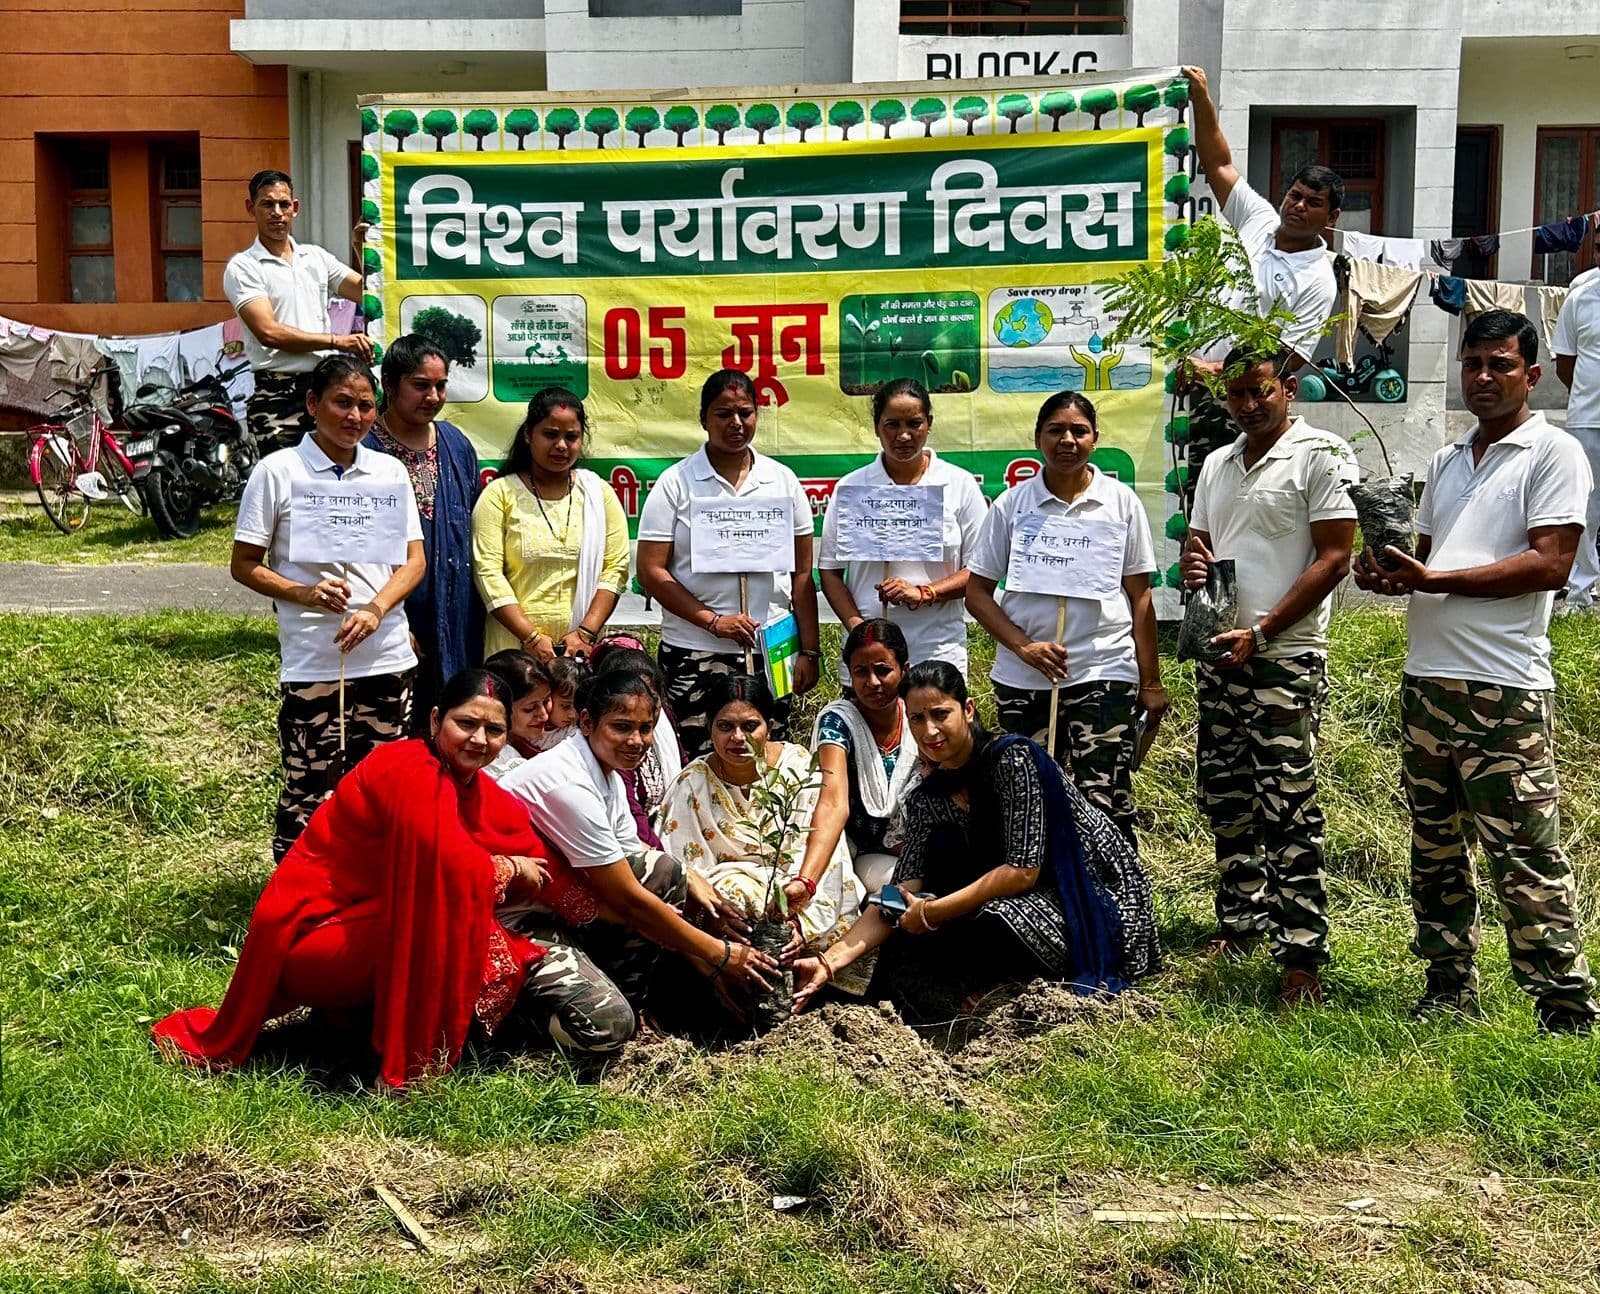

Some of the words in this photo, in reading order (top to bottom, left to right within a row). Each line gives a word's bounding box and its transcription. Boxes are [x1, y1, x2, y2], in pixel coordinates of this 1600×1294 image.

[404, 173, 585, 267] विश्व
[602, 167, 908, 264] पर्यावरण
[925, 158, 1142, 255] दिवस
[1007, 288, 1030, 297] Save
[1031, 287, 1057, 298] every
[1058, 286, 1081, 297] drop
[604, 307, 686, 379] 05
[714, 303, 829, 408] जून
